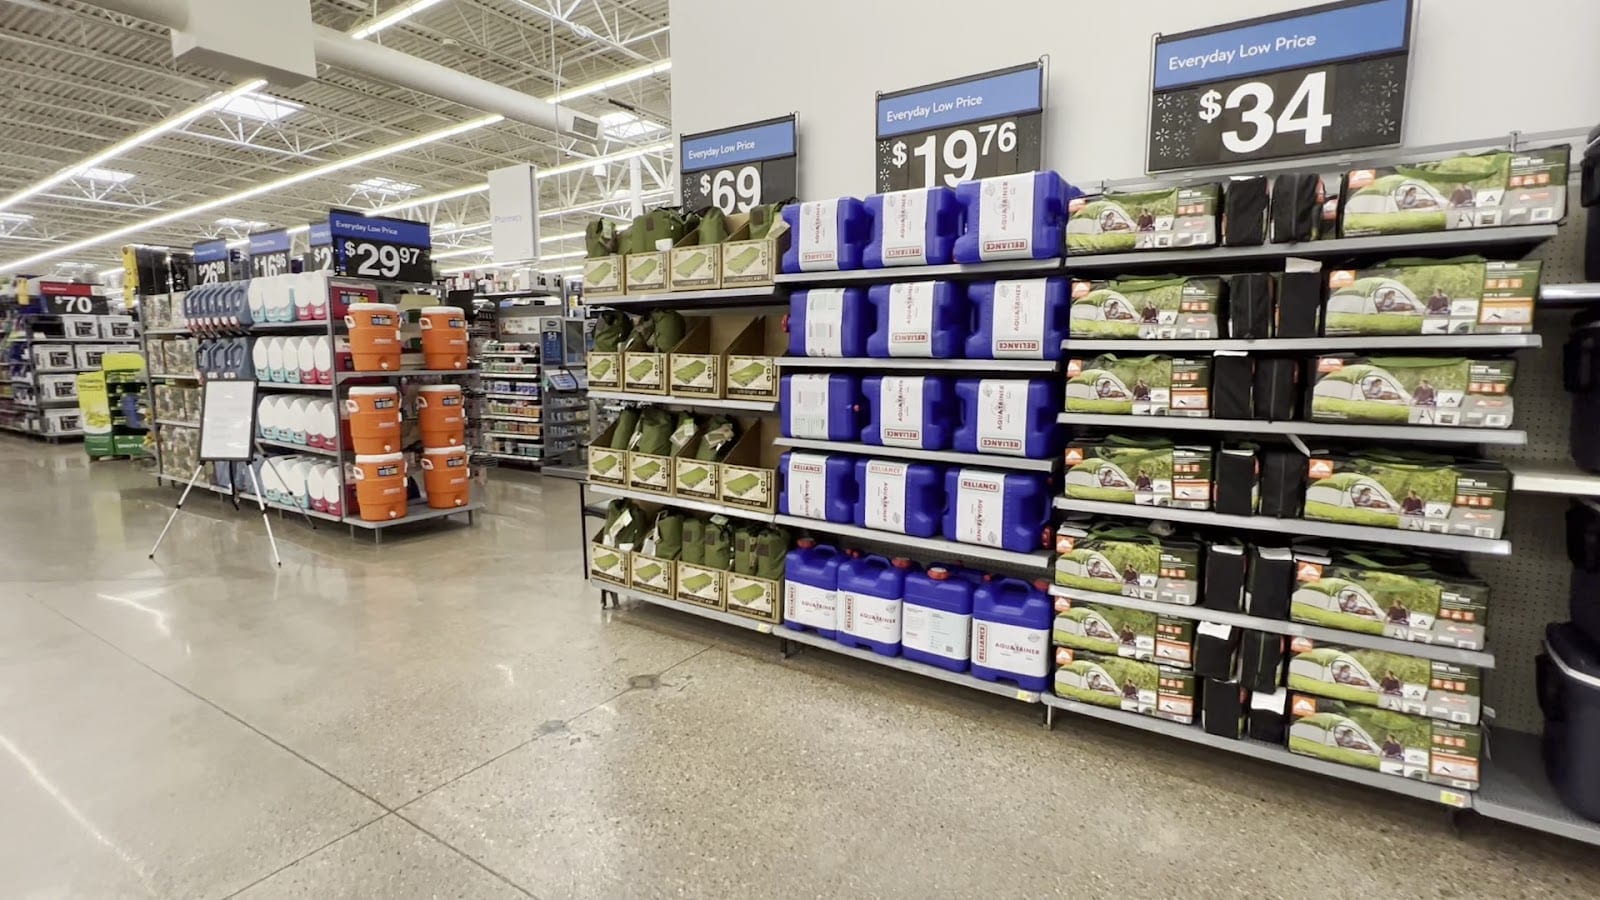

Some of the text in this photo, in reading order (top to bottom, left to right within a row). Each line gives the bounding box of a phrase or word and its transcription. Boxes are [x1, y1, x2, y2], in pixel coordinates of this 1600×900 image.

[1168, 34, 1317, 71] Everyday Low Price
[886, 94, 983, 123] Everyday Low Price
[1199, 71, 1332, 153] $34
[688, 140, 755, 161] Everyday Low Price
[700, 166, 761, 216] $69
[335, 220, 398, 236] Everyday Low Price
[985, 240, 1026, 251] RELIANCE
[54, 295, 93, 313] $70
[999, 341, 1037, 350] RELIANCE
[886, 430, 919, 440] RELIANCE
[983, 439, 1020, 449] RELIANCE
[792, 464, 822, 473] RELIANCE
[963, 481, 998, 491] RELIANCE
